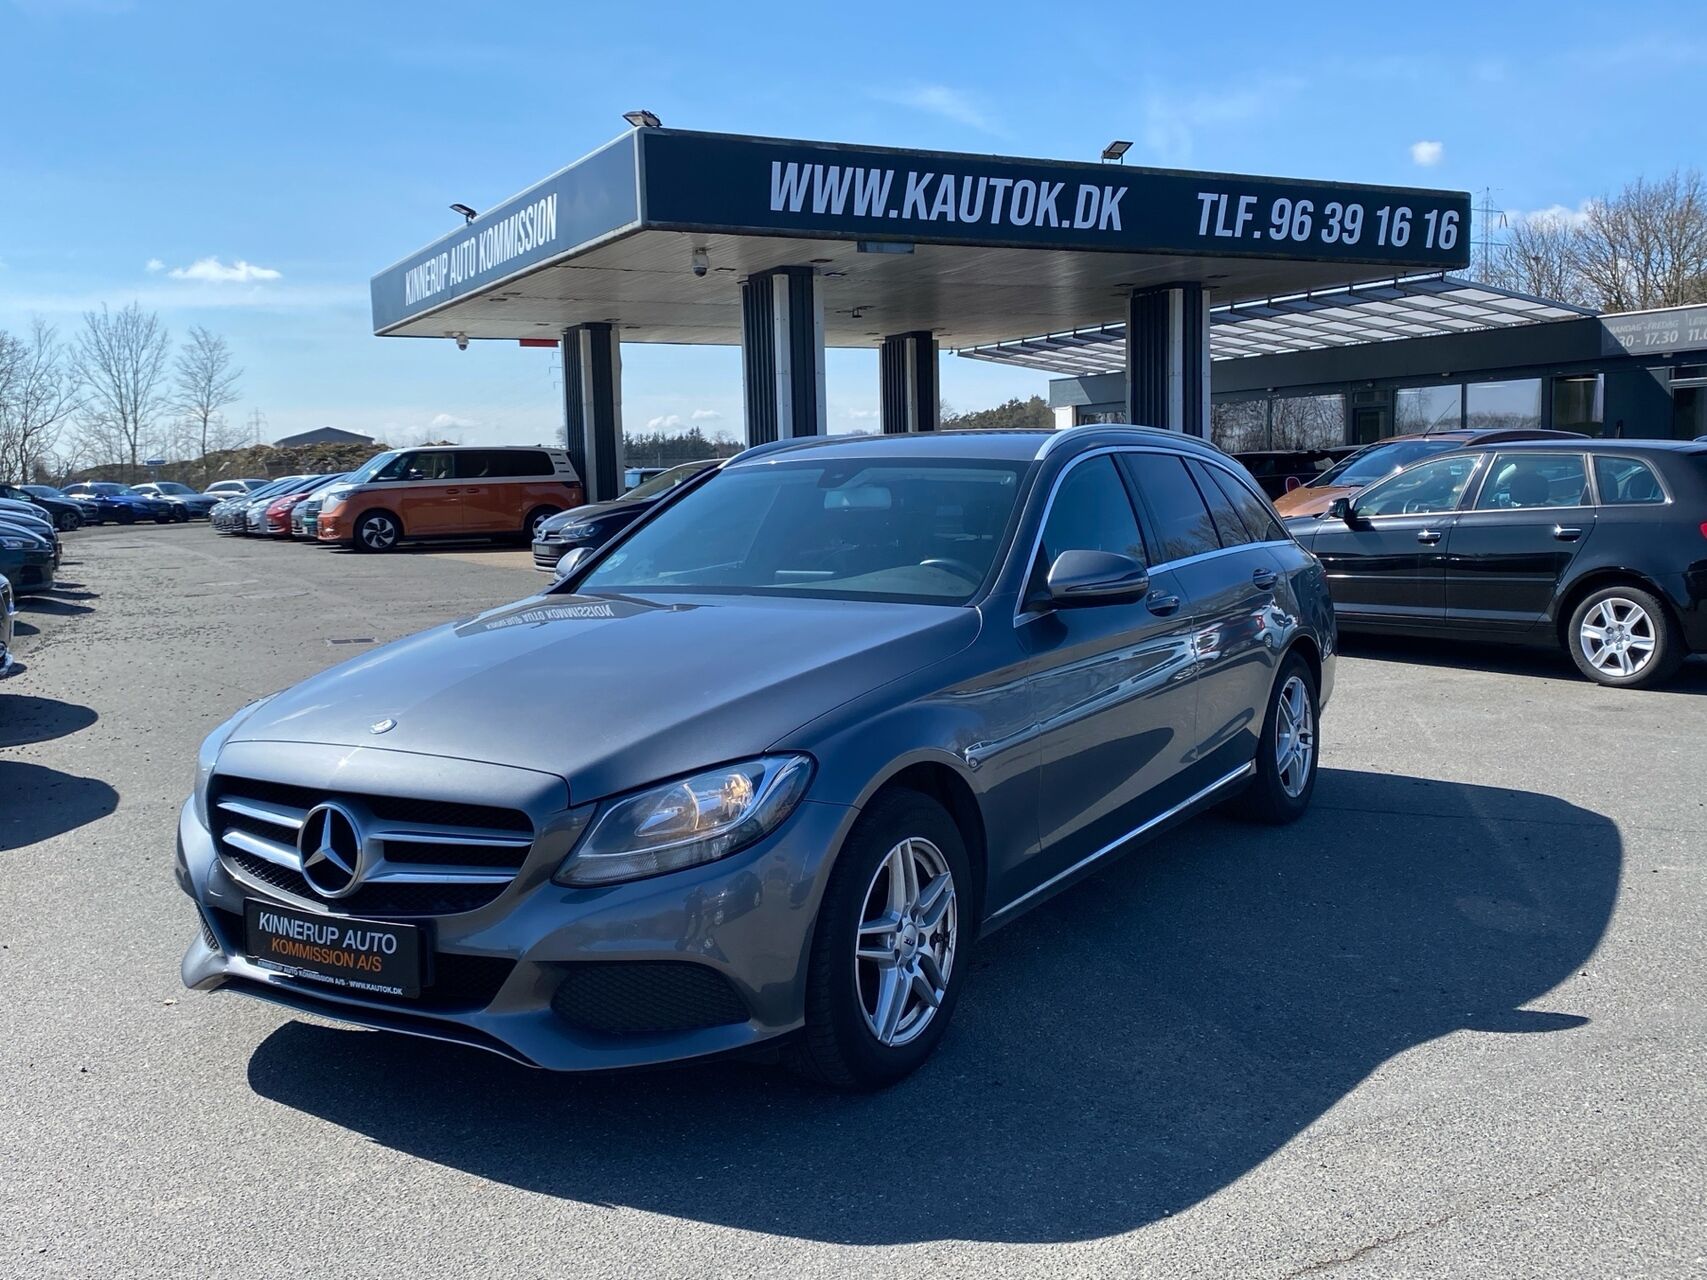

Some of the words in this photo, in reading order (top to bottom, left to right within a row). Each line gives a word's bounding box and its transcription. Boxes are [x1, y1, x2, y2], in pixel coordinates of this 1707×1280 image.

[770, 161, 1128, 231] WWW.KAUTOK.DK
[1198, 192, 1261, 239] TLF.
[1269, 198, 1314, 241] 96
[1321, 202, 1364, 244] 39
[1376, 206, 1412, 247] 16
[1424, 210, 1460, 250] 16
[405, 252, 448, 306] KINNERUP
[450, 237, 476, 286] AUTO
[479, 193, 557, 273] KOMMISSION
[1645, 330, 1679, 345] 17.30
[259, 912, 339, 946] KINNERUP
[342, 929, 397, 955] AUTO
[271, 937, 354, 968] KOMMISSION
[357, 954, 382, 972] A/S
